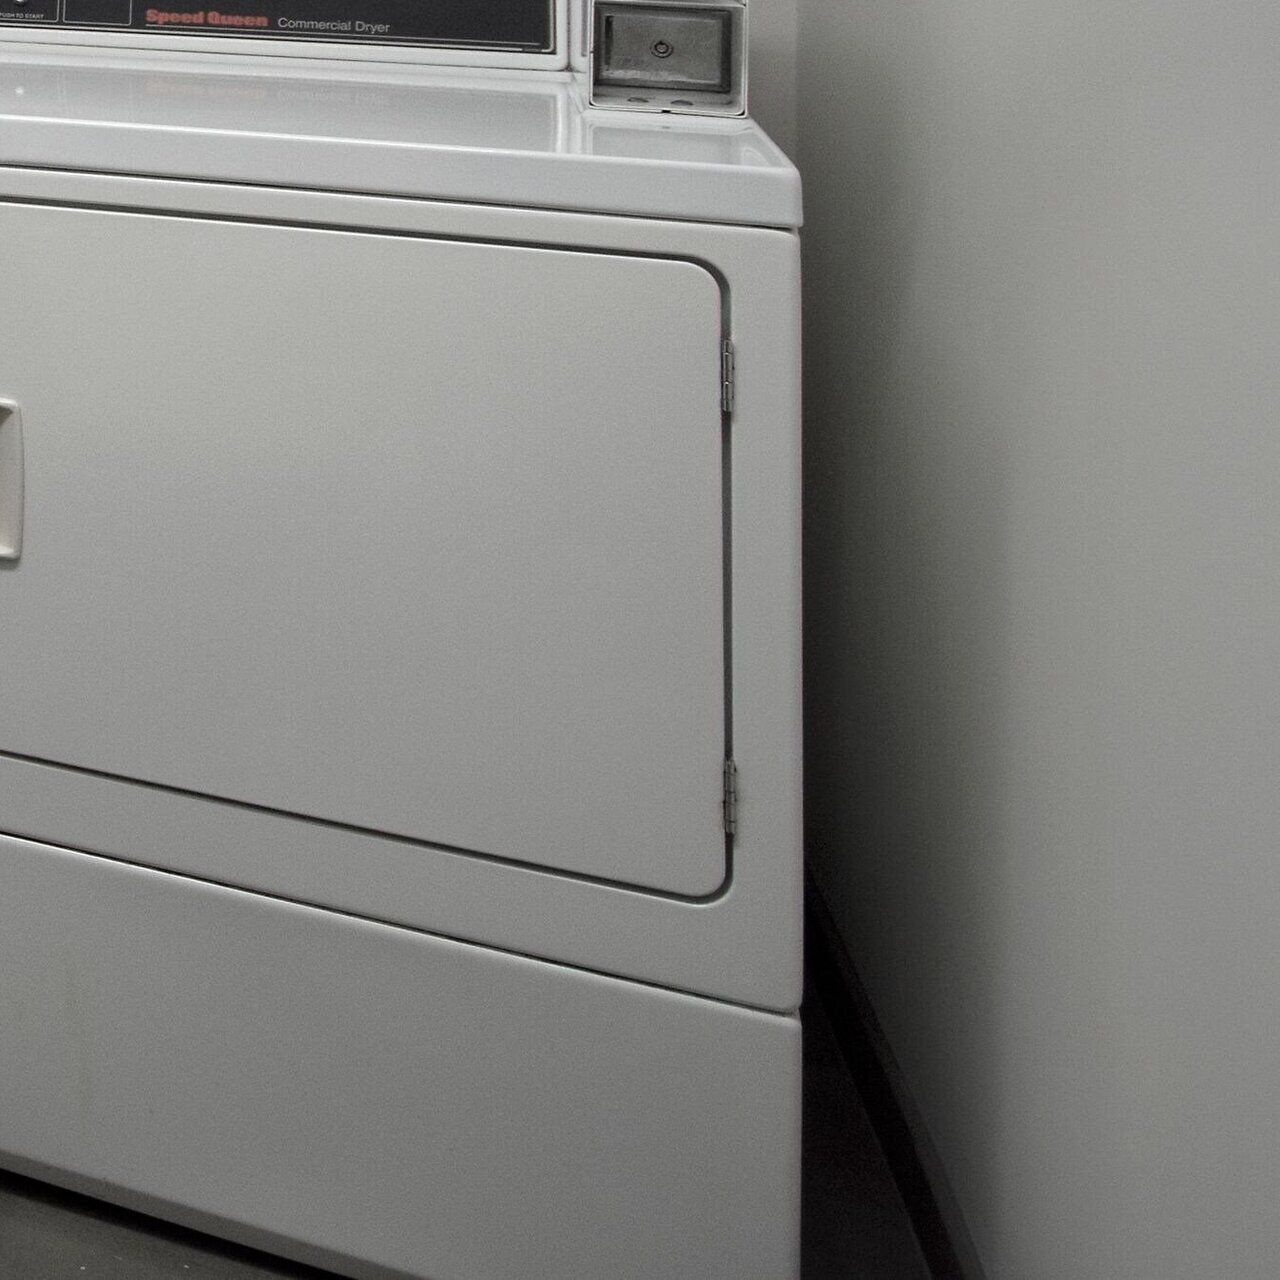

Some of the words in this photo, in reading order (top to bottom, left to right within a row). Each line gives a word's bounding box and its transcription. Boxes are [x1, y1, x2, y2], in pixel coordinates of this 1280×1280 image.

[146, 9, 205, 26] Speed
[207, 11, 268, 27] Queen
[277, 17, 351, 31] Commercial
[355, 20, 390, 34] Dryer
